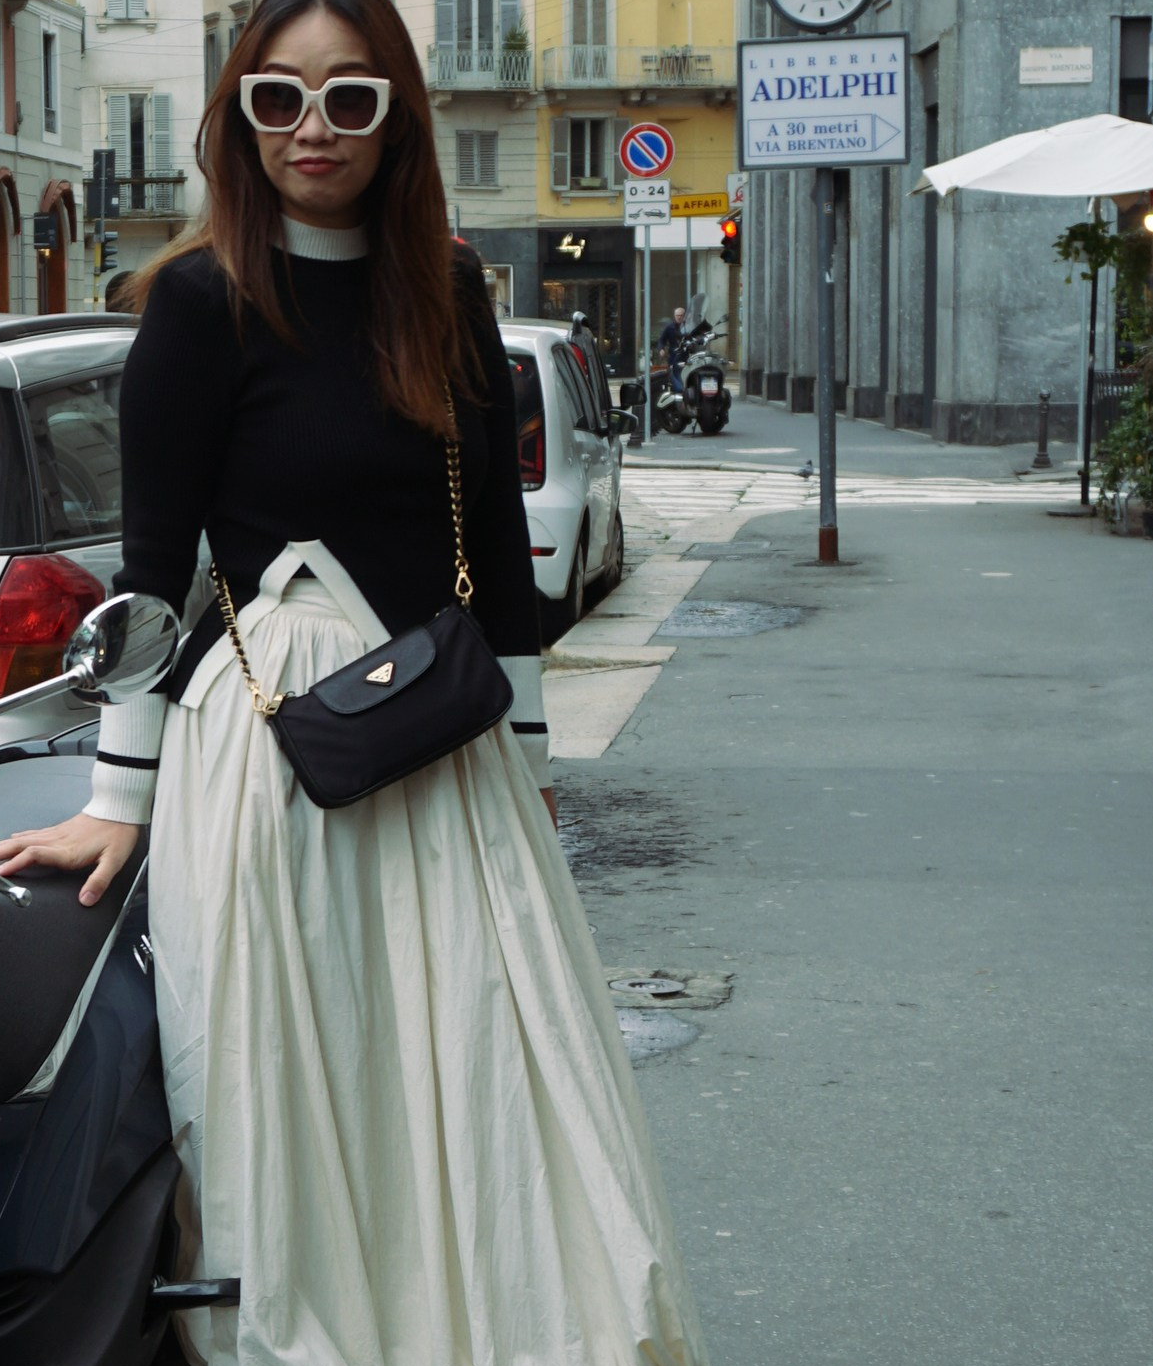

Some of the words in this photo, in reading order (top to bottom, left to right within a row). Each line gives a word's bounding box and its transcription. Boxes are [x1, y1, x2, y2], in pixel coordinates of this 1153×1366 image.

[749, 52, 898, 70] LIBRERIA
[1051, 63, 1091, 72] BRENTANO
[750, 71, 898, 103] ADELPHI
[768, 123, 779, 137] A
[786, 121, 806, 136] 30
[814, 119, 859, 134] metri
[755, 140, 782, 153] VIA
[787, 137, 867, 152] BRENTANO
[683, 199, 723, 210] AFFARI
